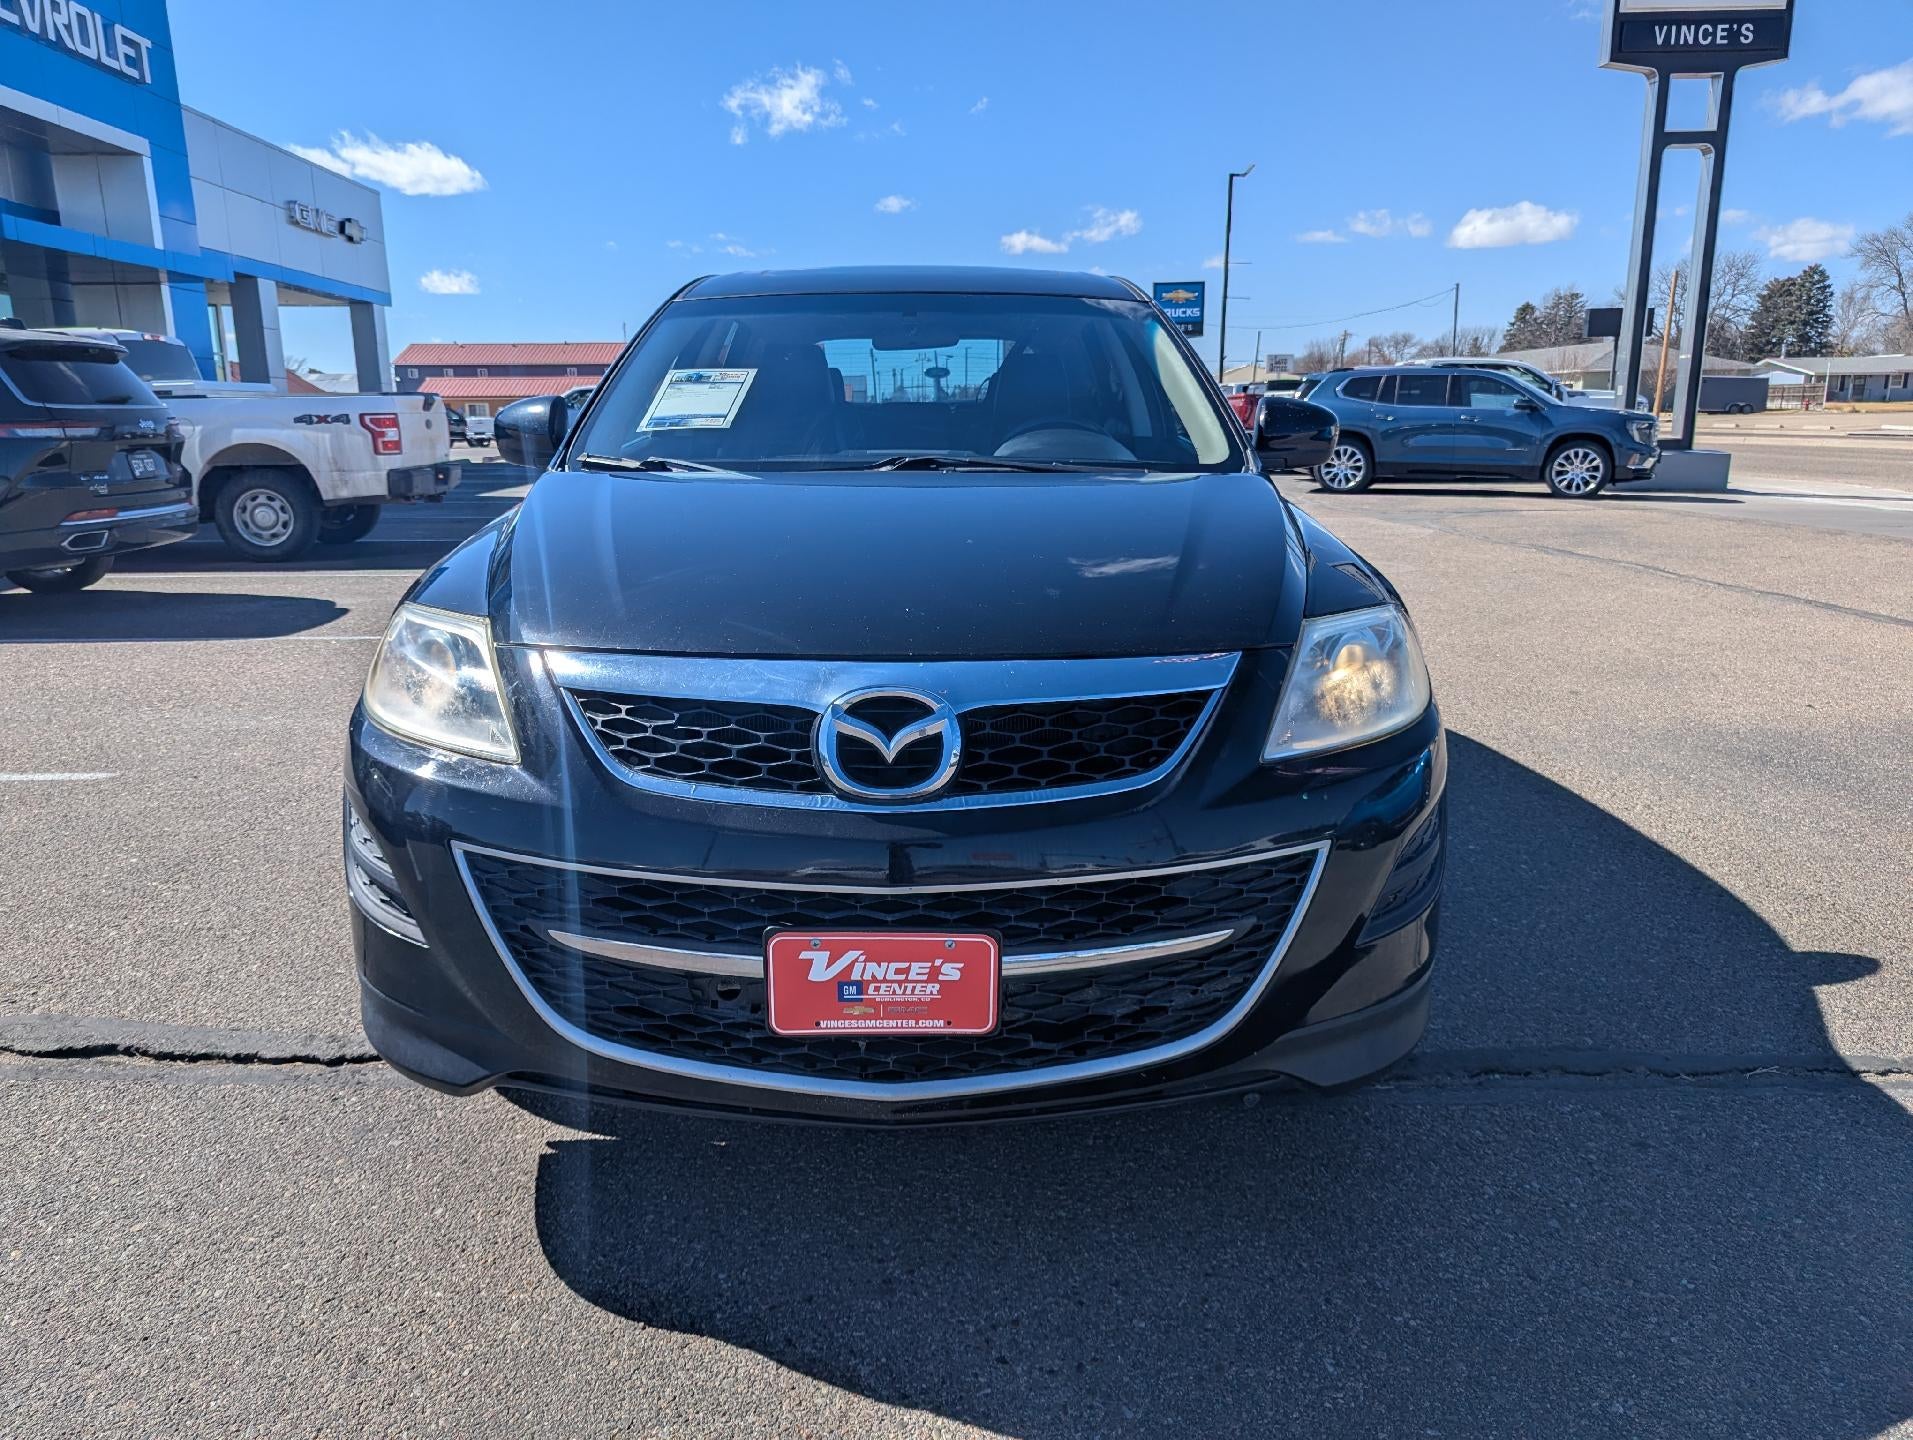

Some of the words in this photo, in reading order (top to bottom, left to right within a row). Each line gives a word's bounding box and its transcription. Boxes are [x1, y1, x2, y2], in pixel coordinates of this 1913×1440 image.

[1654, 23, 1754, 45] VINCE'S
[1163, 307, 1200, 317] RUCKS
[843, 985, 857, 995] GM
[867, 983, 940, 995] CENTER
[819, 1019, 944, 1028] VINCESGMCENTER.COM
